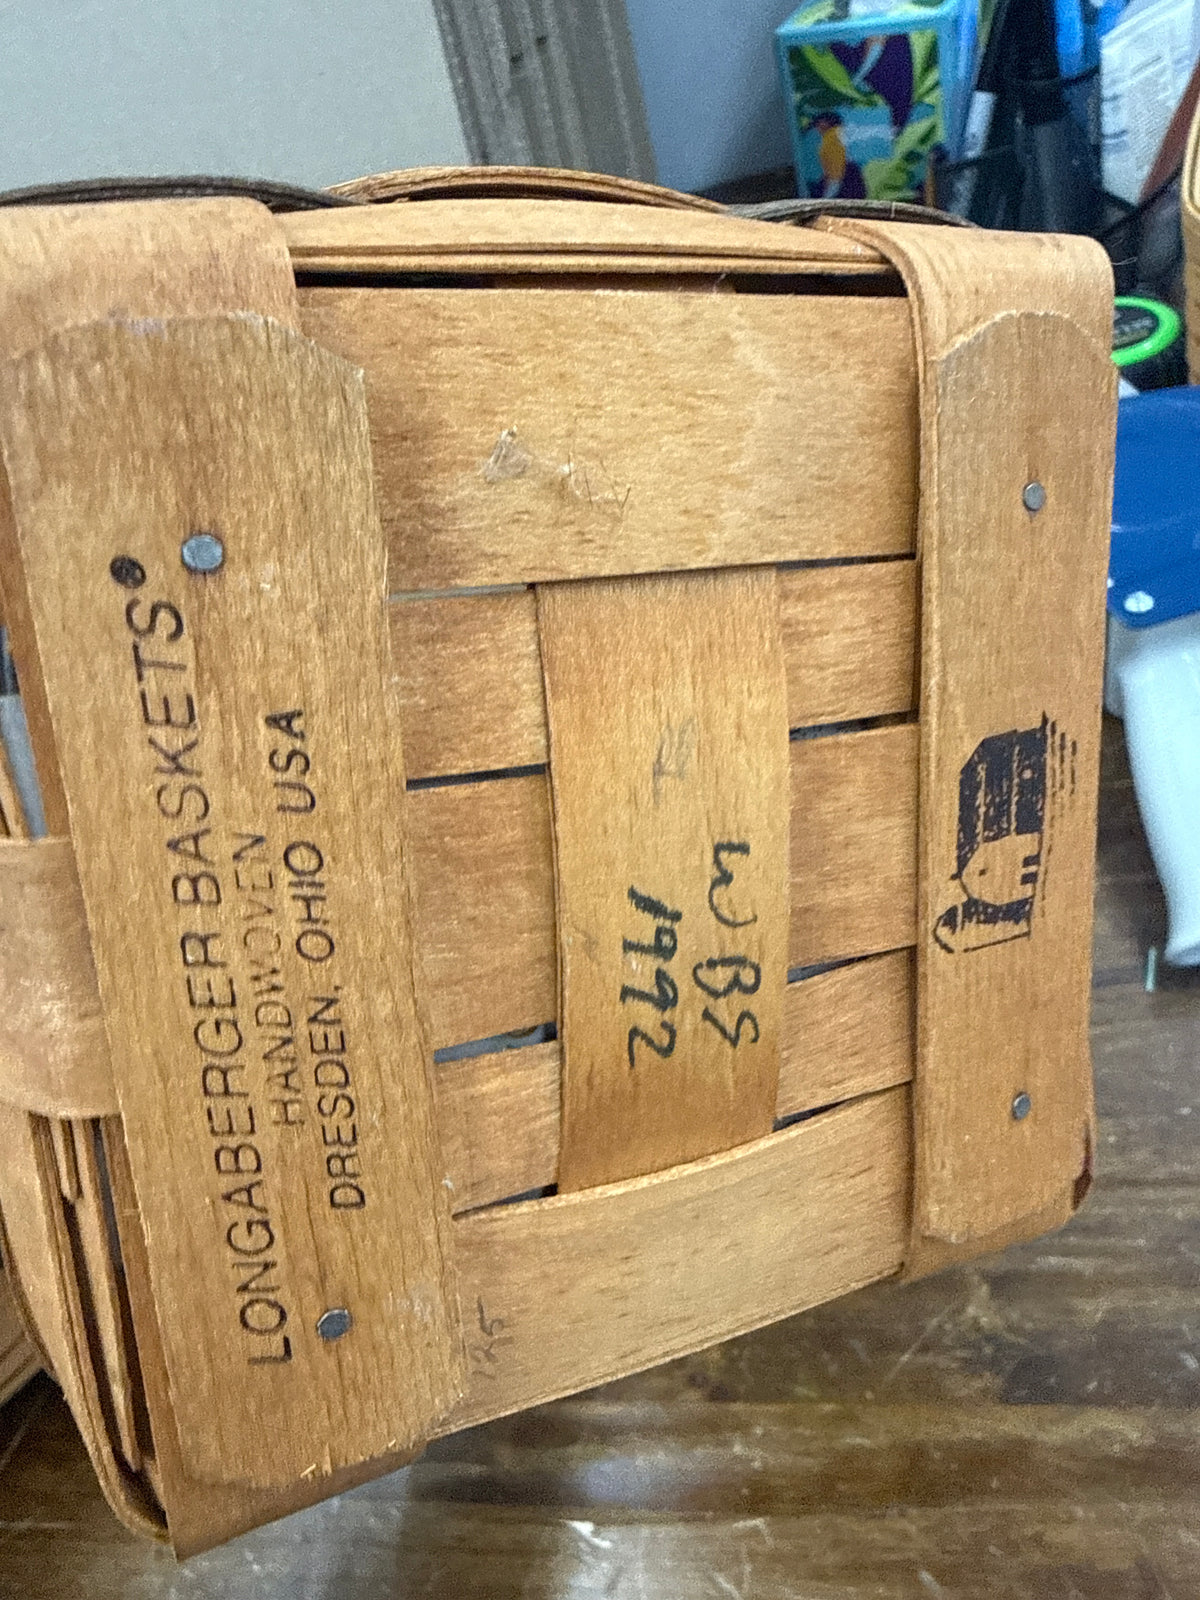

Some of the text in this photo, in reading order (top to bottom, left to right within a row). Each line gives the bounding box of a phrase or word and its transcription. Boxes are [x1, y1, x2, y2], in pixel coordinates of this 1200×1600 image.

[264, 708, 318, 815] USA
[231, 831, 305, 1128] HANDWOVEN
[282, 840, 336, 961] OHIO
[619, 884, 683, 1071] 1992
[180, 930, 294, 1367] LONGABERGER
